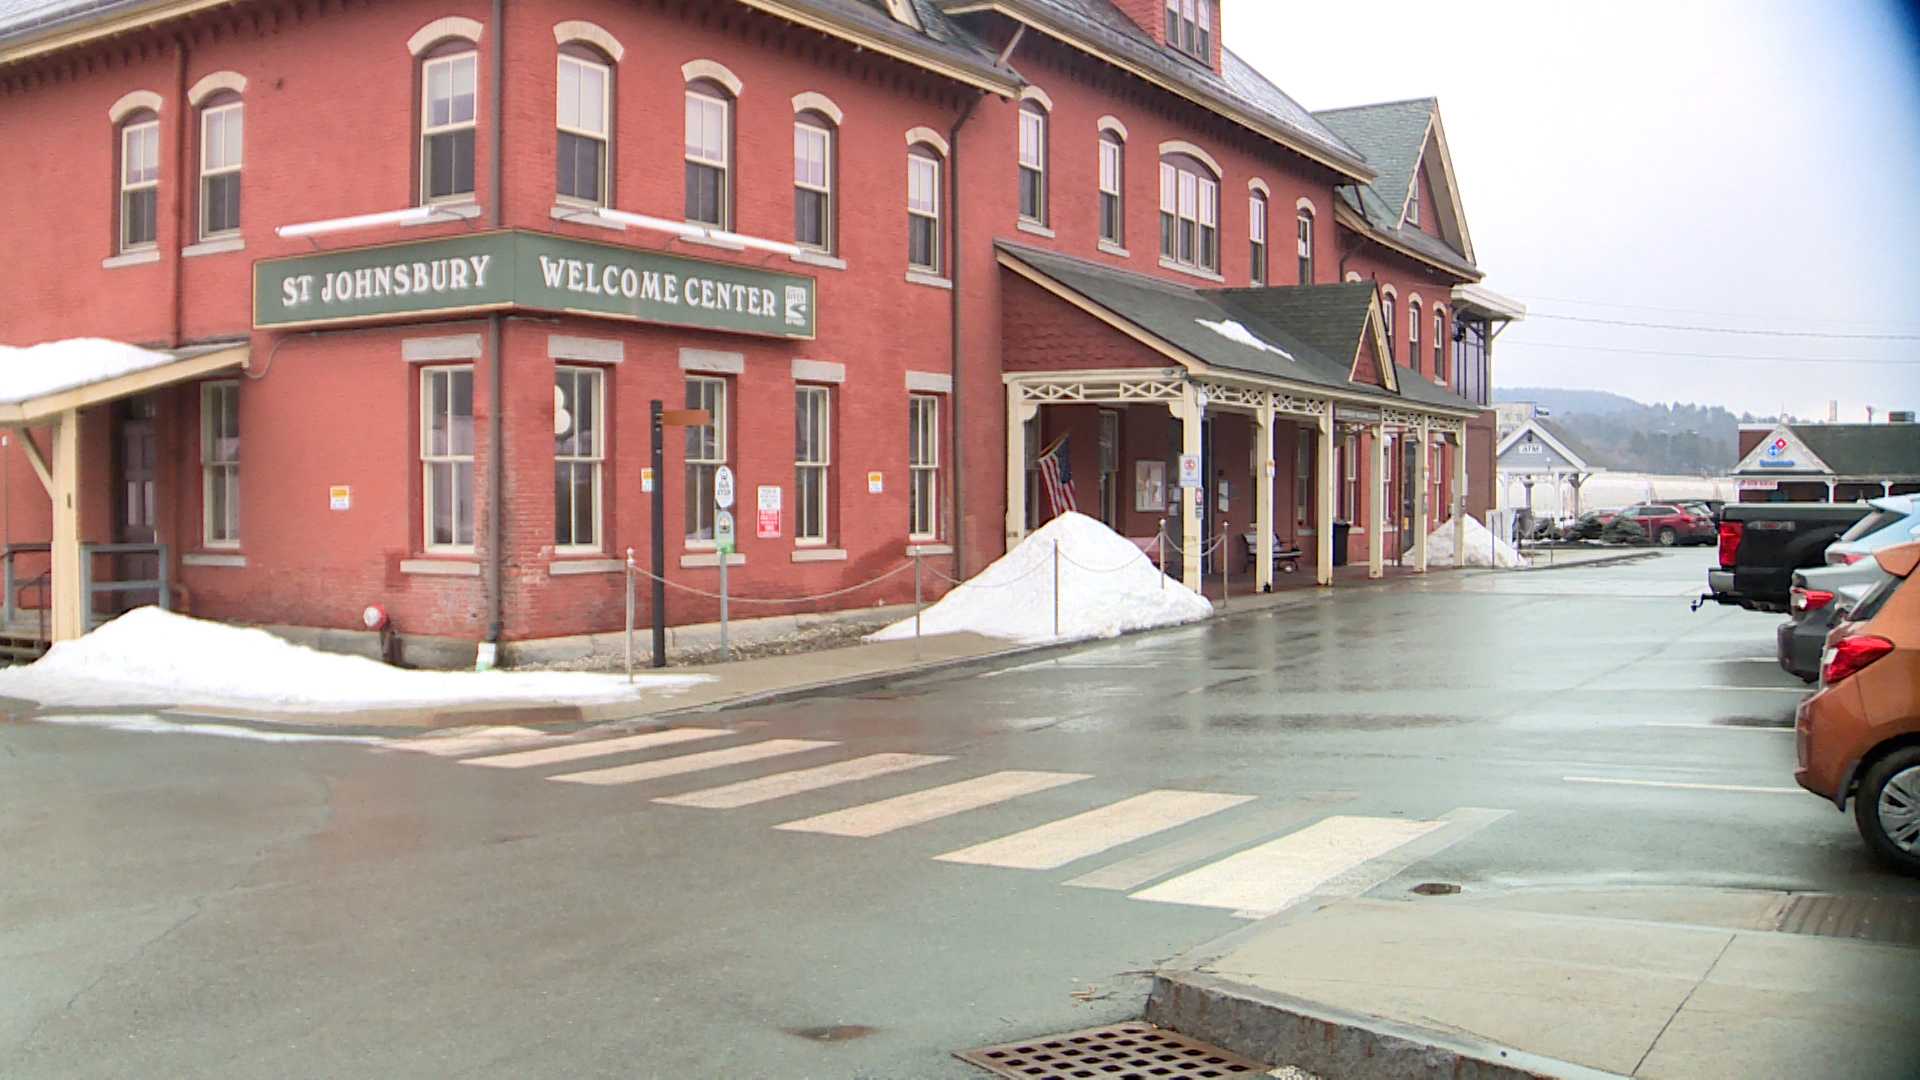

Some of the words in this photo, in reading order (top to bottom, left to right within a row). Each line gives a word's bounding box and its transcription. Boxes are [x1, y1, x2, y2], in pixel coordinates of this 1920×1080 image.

[282, 275, 313, 307] ST
[320, 254, 491, 302] JOHNSBURY
[538, 255, 679, 304] WELCOME
[684, 277, 777, 317] CENTER
